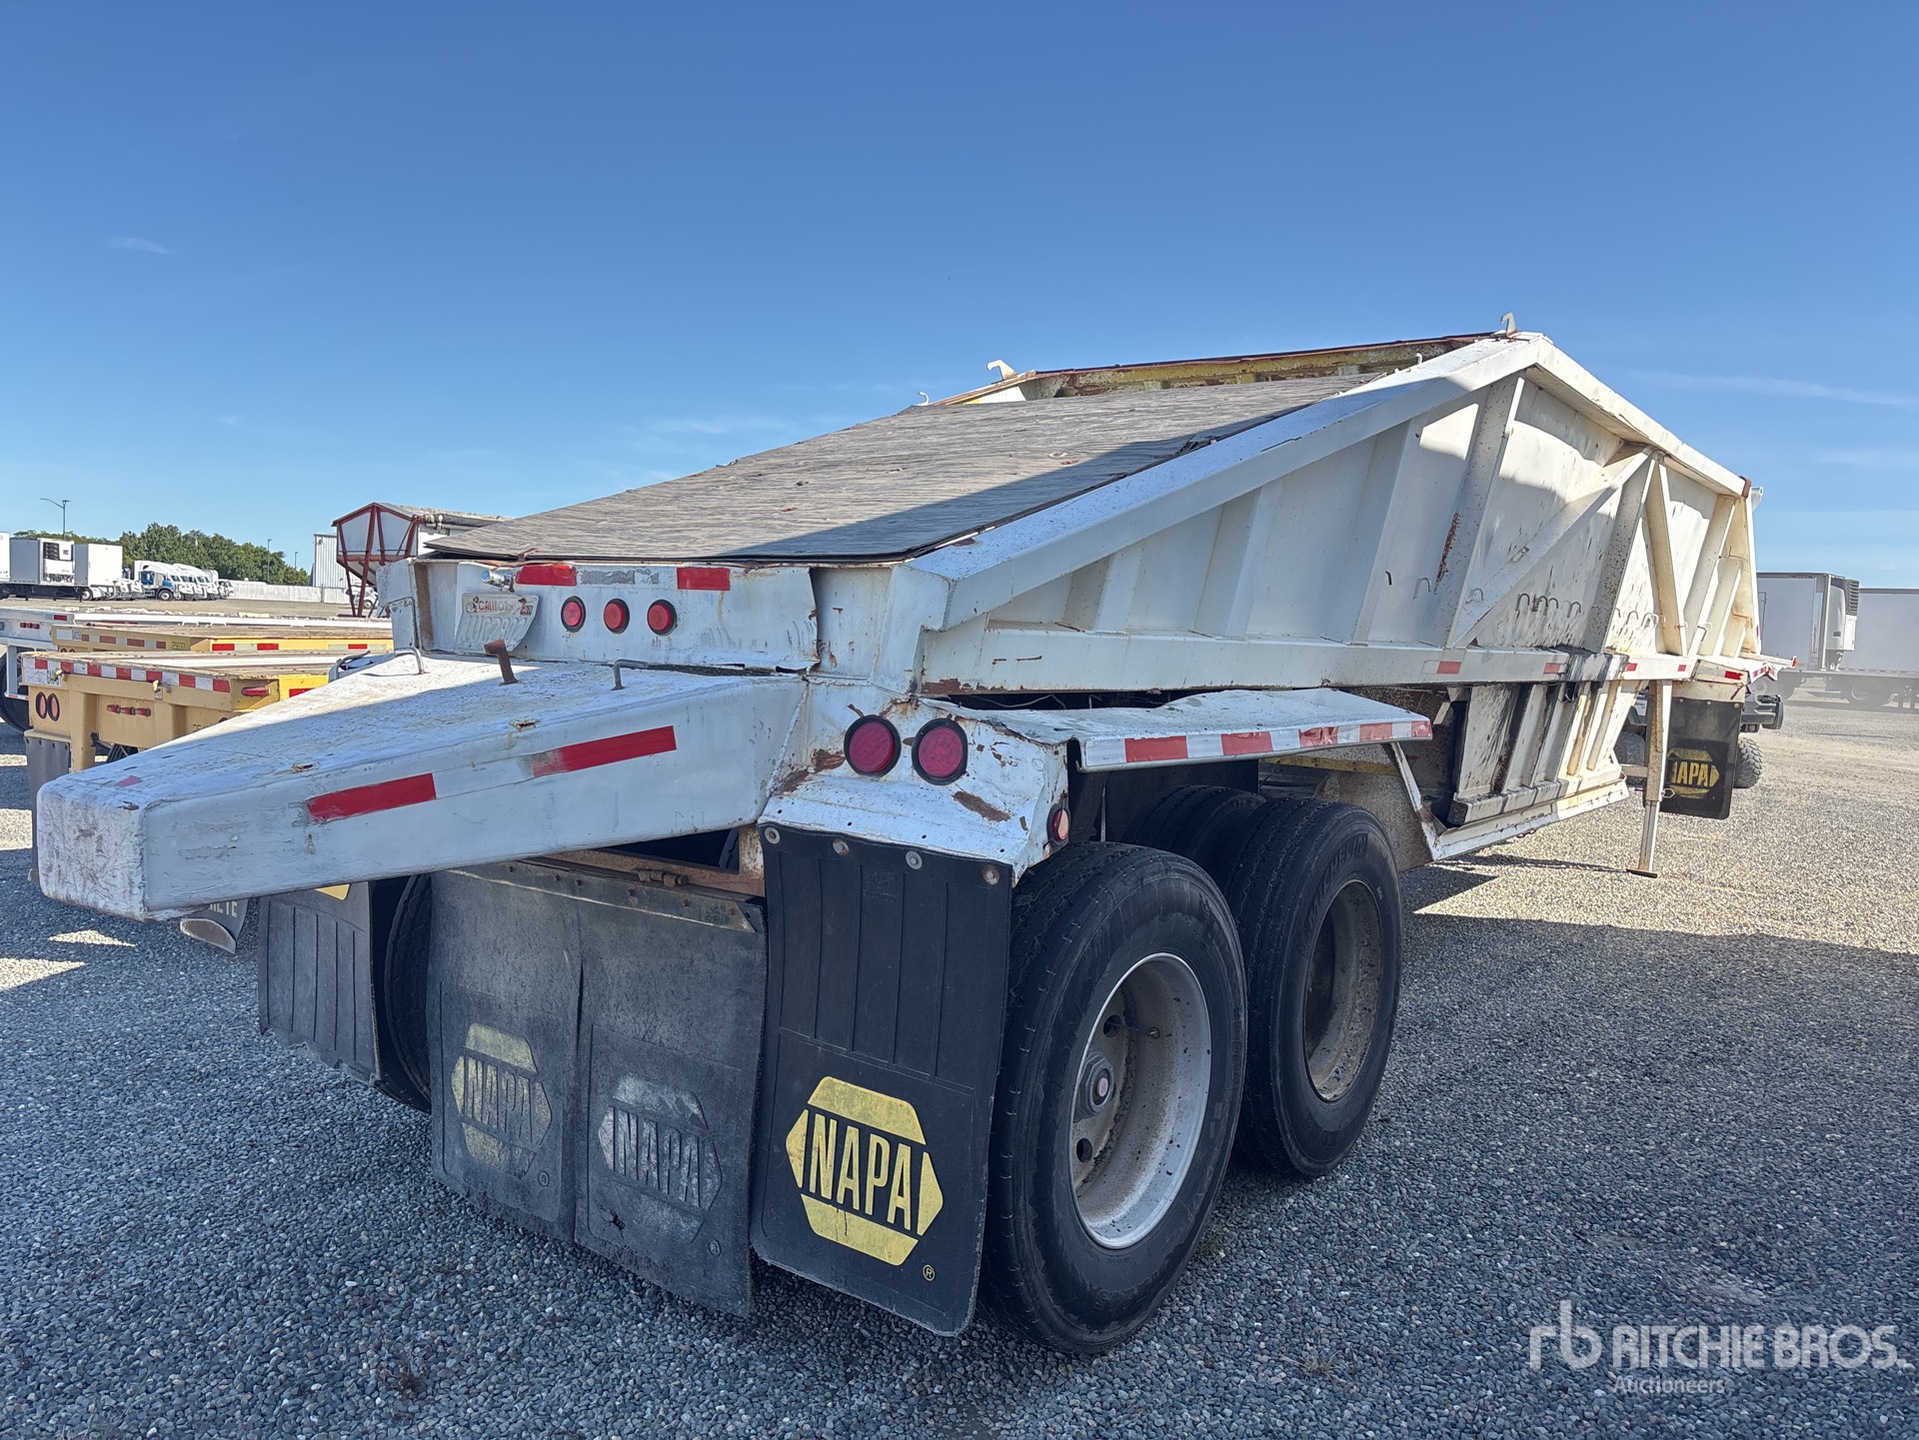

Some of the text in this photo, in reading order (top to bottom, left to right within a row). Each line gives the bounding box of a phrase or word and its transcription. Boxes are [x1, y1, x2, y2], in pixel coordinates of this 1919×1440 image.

[478, 600, 521, 613] CALIFORN
[466, 1056, 532, 1143] NAPA
[618, 1109, 701, 1208] NAPA
[808, 1112, 912, 1231] NAPA
